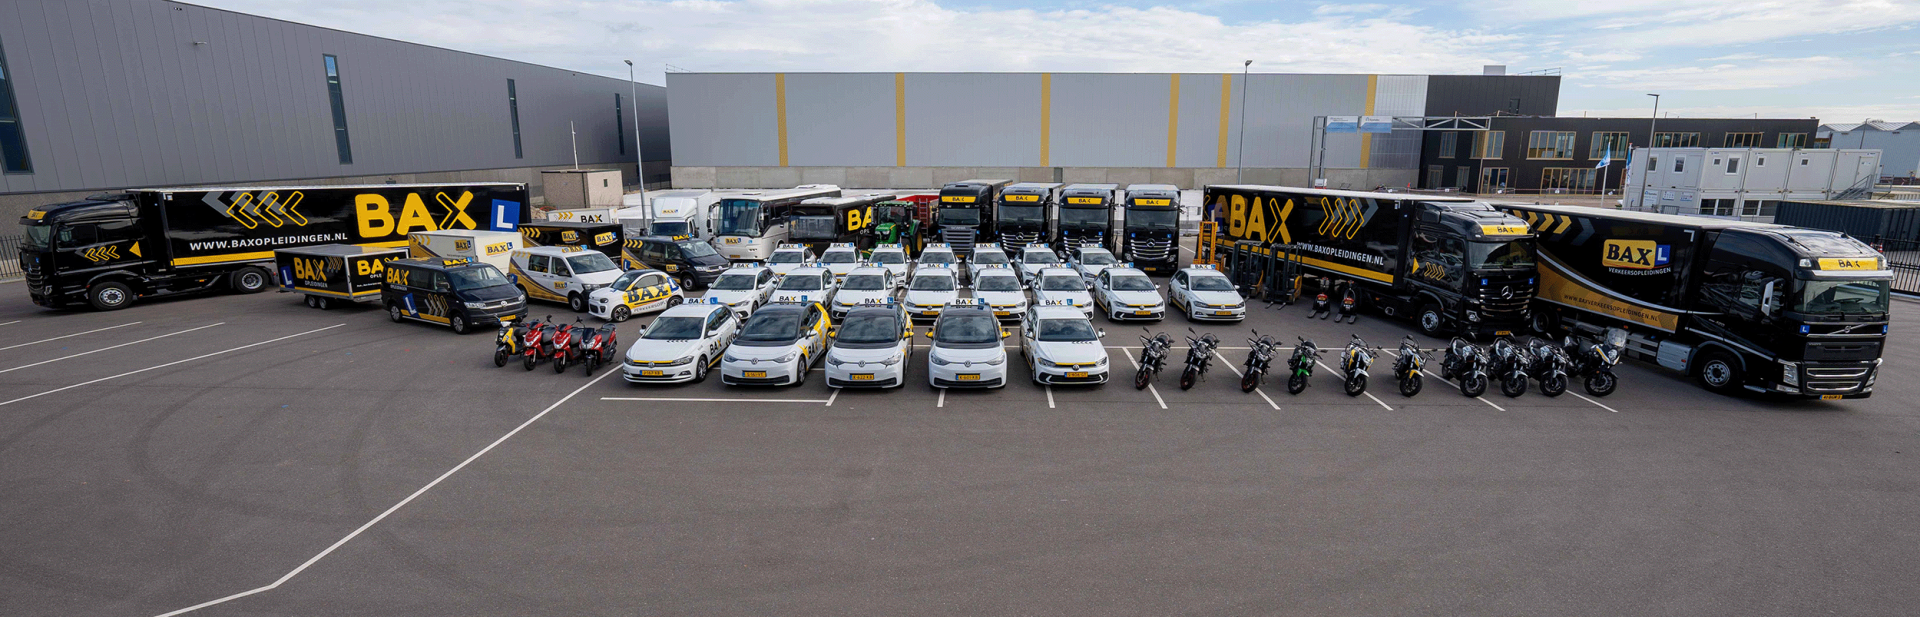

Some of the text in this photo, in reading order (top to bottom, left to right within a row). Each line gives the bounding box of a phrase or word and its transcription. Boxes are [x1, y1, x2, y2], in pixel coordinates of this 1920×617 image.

[355, 190, 514, 238] BAX L
[581, 214, 603, 223] BAX
[1230, 194, 1294, 244] BAX
[190, 233, 348, 250] WWW.BAXOPLEIDINGEN.NL
[563, 231, 576, 240] BAX
[597, 234, 612, 242] BAX
[456, 241, 467, 249] BAX
[487, 245, 507, 253] BAX
[1606, 244, 1667, 266] BAX L
[294, 257, 327, 282] BAX
[1609, 267, 1671, 275] VERKEERSOPLEIDINGEN
[1839, 260, 1860, 268] BAX
[283, 270, 292, 285] L
[387, 268, 409, 286] BAX
[669, 278, 678, 288] L
[627, 286, 668, 303] BAX
[405, 297, 417, 314] L
[710, 337, 721, 355] BAX
